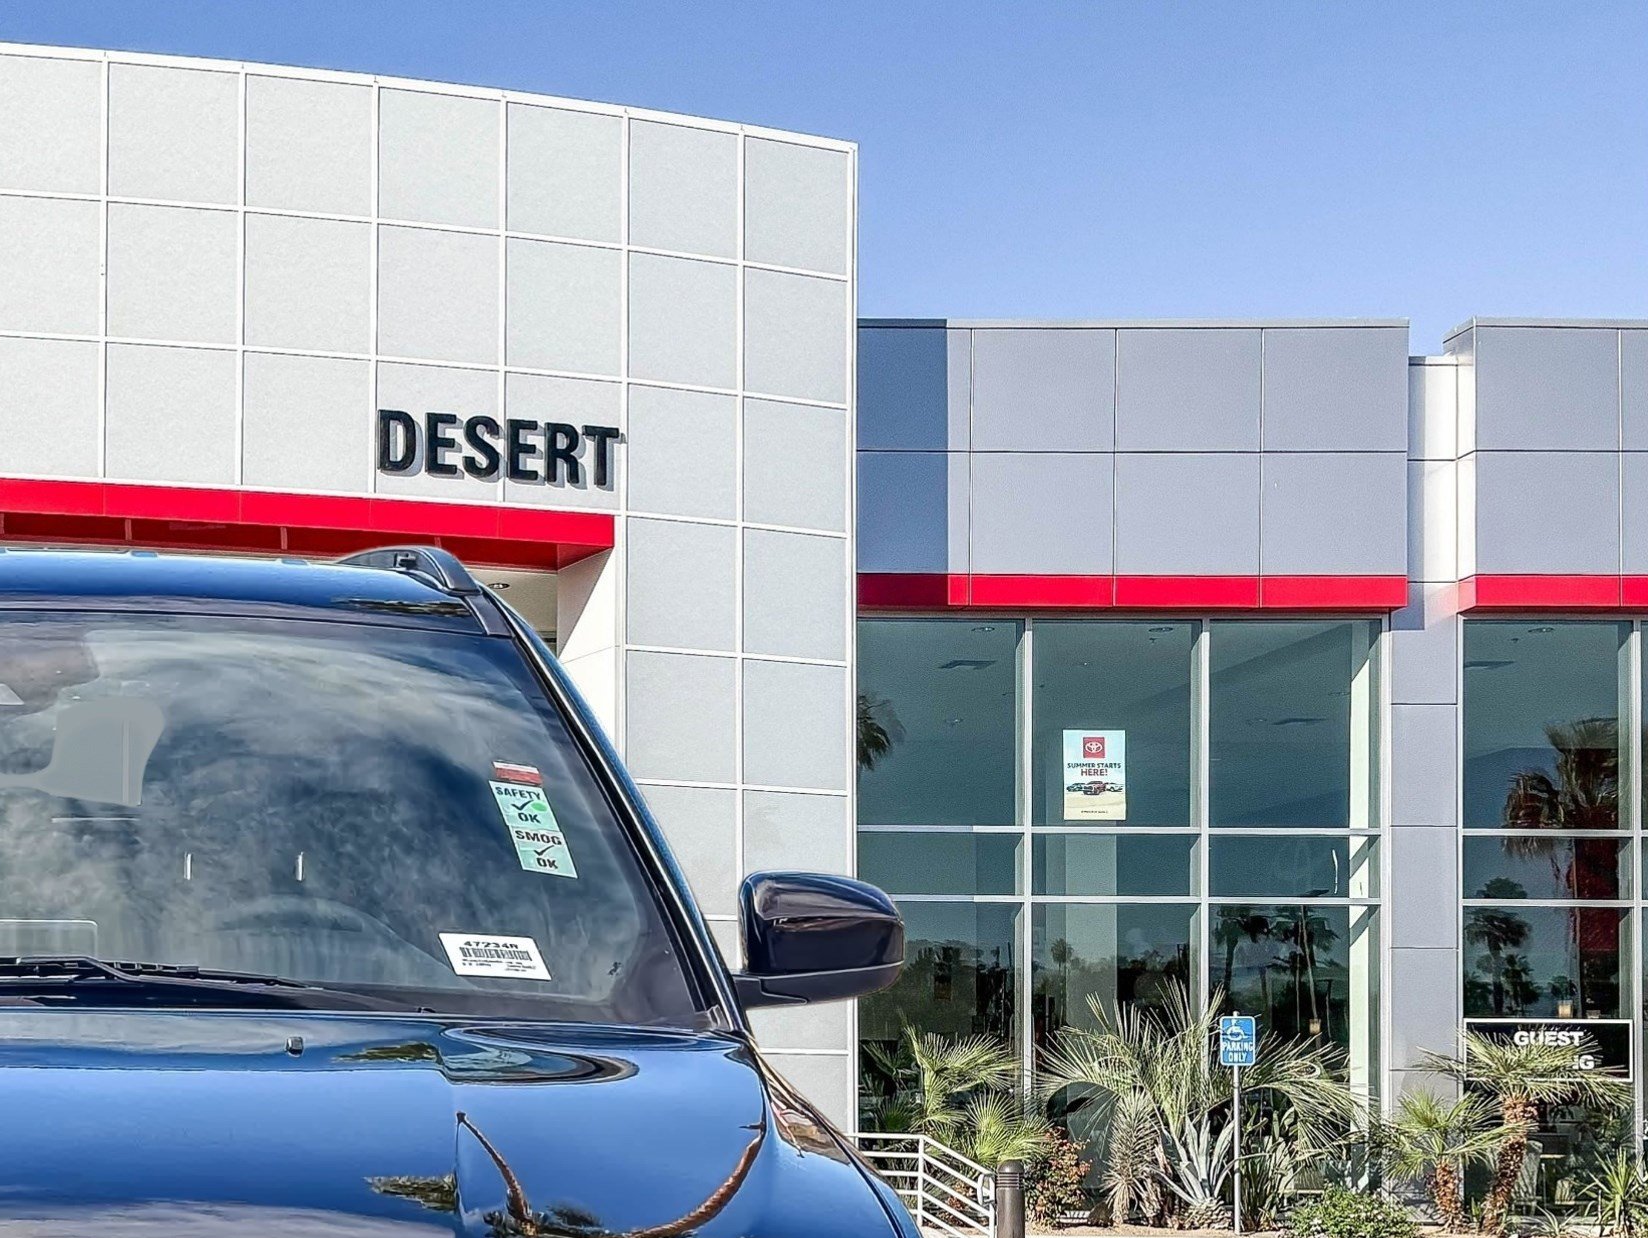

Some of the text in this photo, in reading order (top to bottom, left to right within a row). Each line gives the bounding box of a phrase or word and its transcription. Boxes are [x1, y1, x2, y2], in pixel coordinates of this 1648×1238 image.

[377, 409, 620, 487] DESERT
[495, 786, 541, 801] SAFETY
[518, 812, 541, 824] OK
[515, 830, 562, 846] SMOG
[536, 857, 558, 870] OK
[1513, 1031, 1585, 1047] GUEST
[1222, 1042, 1253, 1052] PARKING
[1228, 1053, 1248, 1062] ONLY
